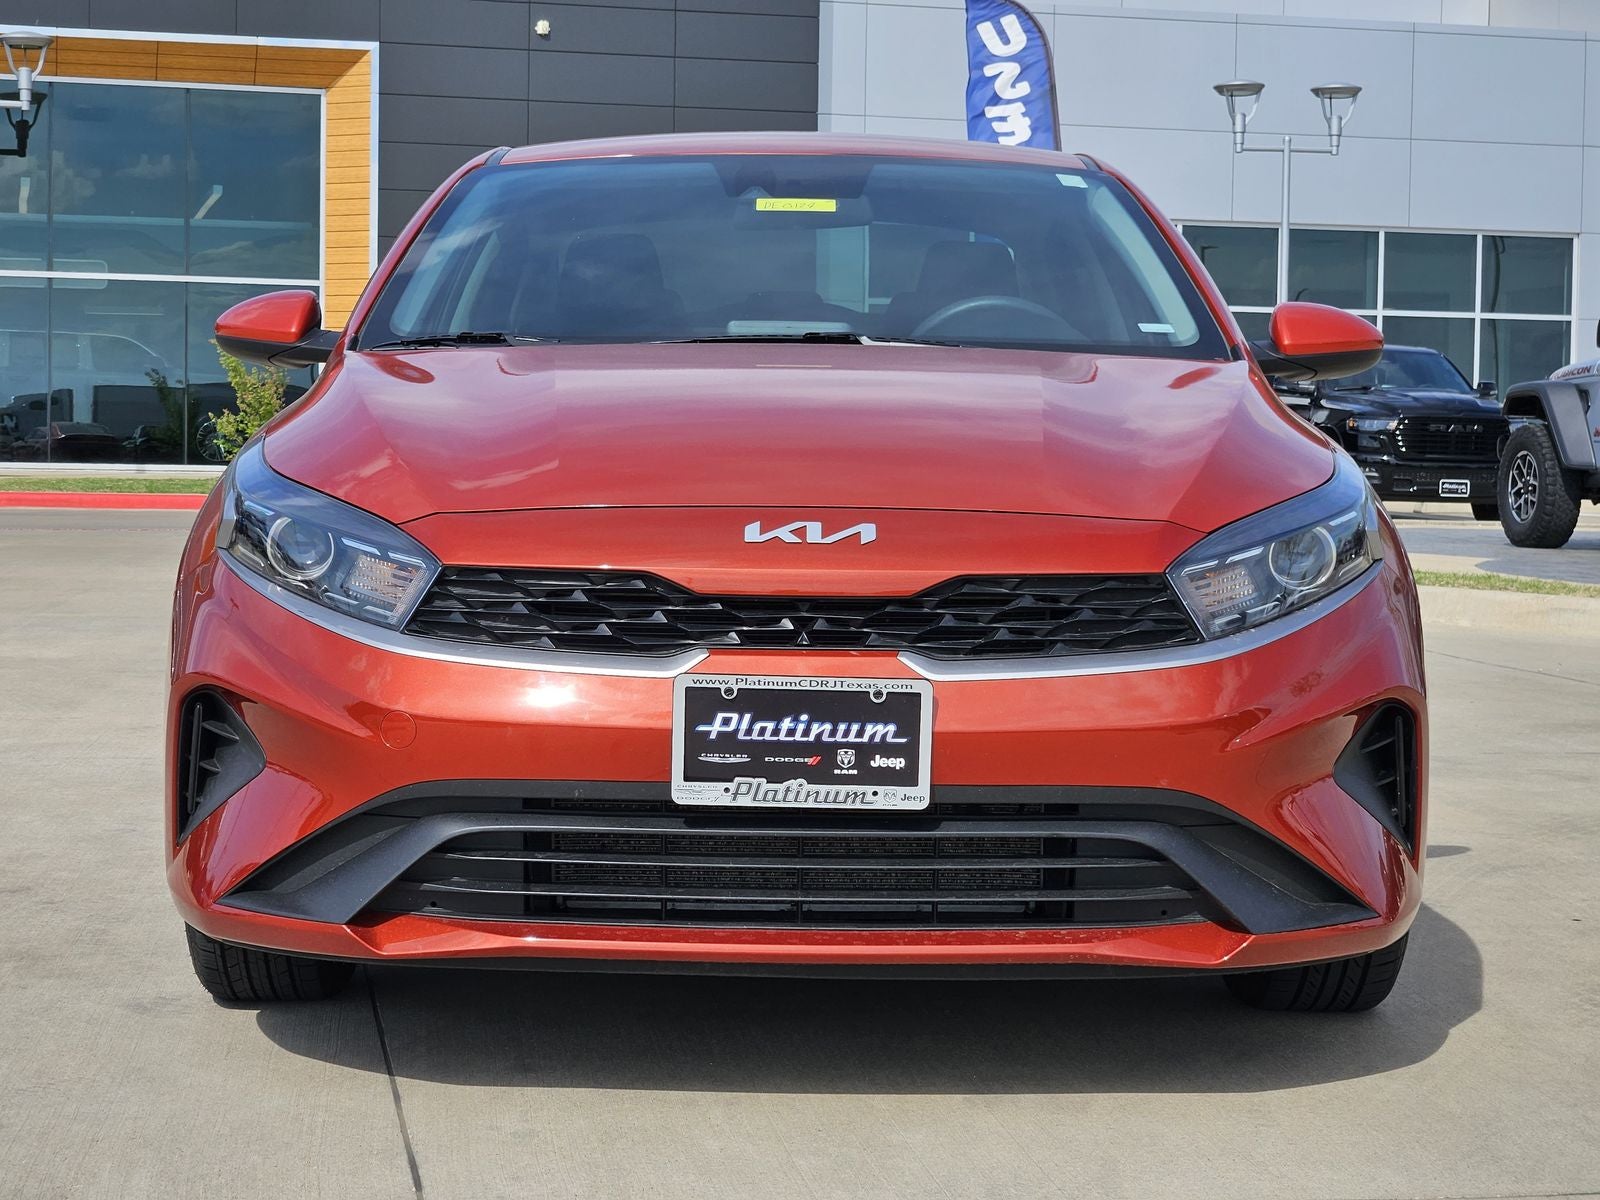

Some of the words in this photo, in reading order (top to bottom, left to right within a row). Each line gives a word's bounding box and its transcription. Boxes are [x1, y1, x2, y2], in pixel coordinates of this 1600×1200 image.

[744, 520, 877, 545] KIA
[692, 678, 914, 690] www.PlatinumCDRJTexas.com
[694, 711, 910, 743] Platinum
[870, 754, 906, 770] Jeep
[731, 781, 877, 805] Platinum
[900, 793, 926, 803] Jeep
